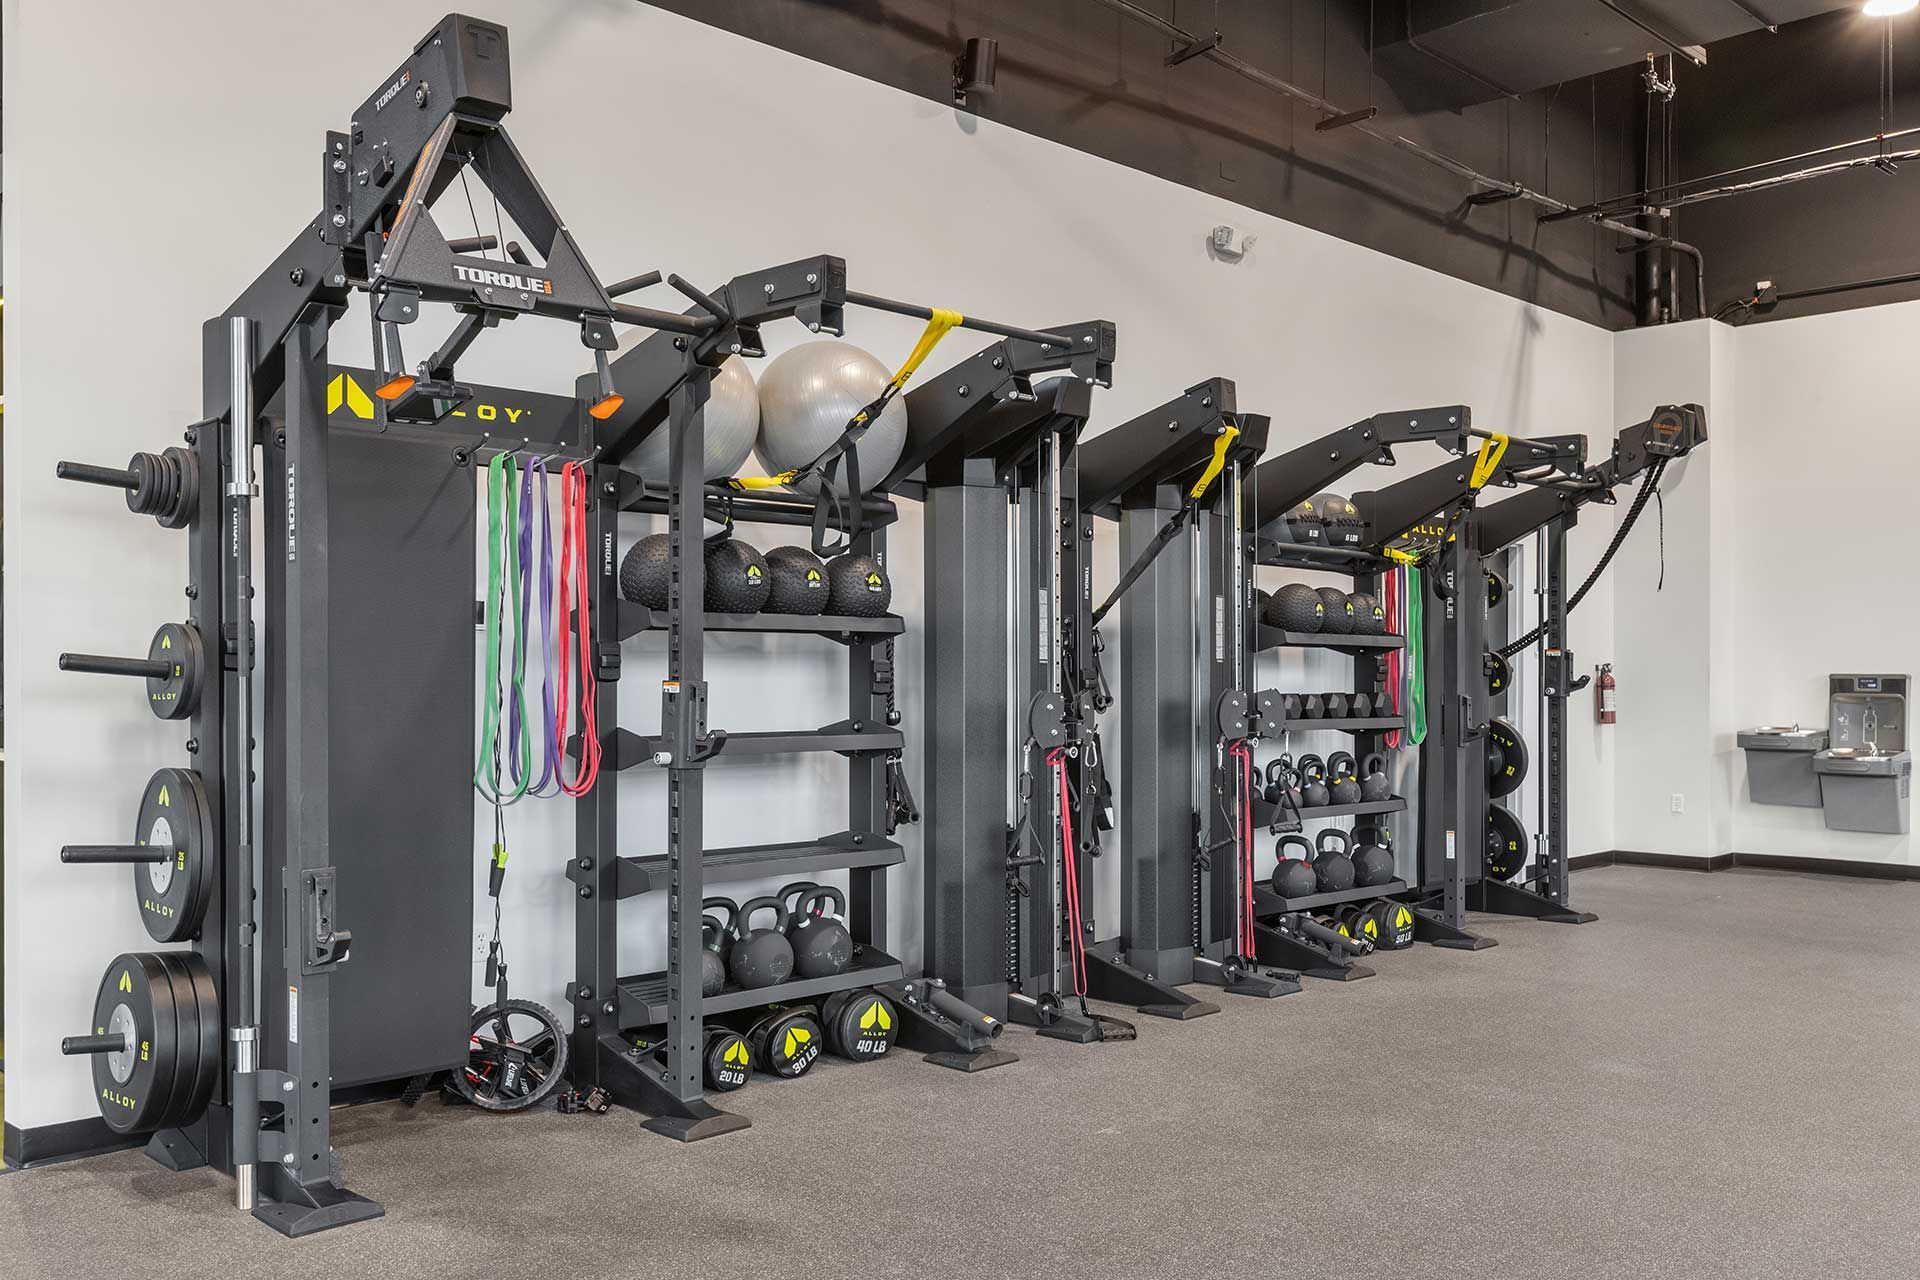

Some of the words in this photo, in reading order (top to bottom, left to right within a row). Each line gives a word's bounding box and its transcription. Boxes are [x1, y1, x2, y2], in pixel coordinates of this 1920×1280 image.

[375, 73, 408, 111] TORQUE
[453, 265, 545, 293] TORQUE
[287, 463, 296, 552] TORQUE
[151, 692, 177, 700] ALLOY
[144, 900, 174, 918] ALLOY
[805, 1045, 818, 1062] LB
[856, 1039, 873, 1053] 40
[872, 1040, 887, 1053] LB
[719, 1070, 733, 1083] 20
[732, 1072, 745, 1084] LB
[102, 1088, 136, 1110] ALLOY
